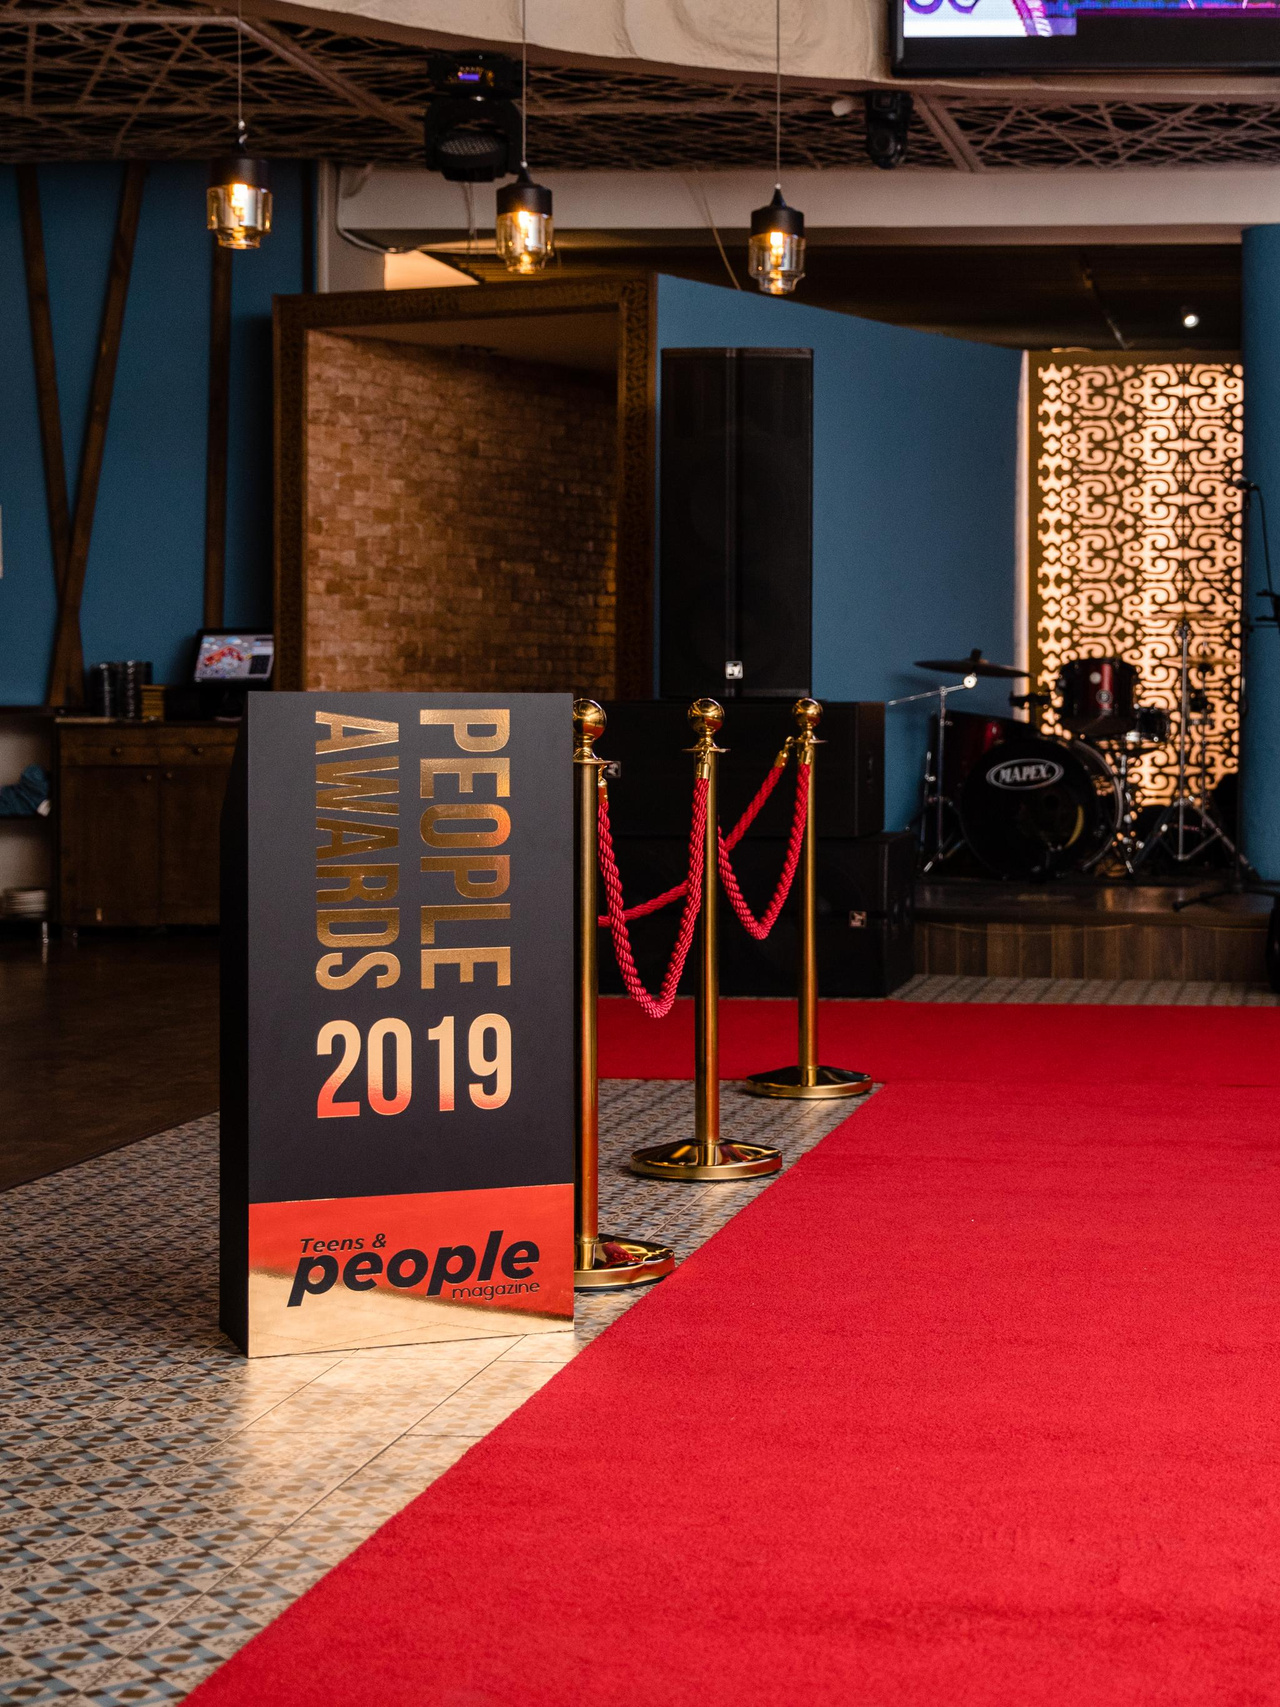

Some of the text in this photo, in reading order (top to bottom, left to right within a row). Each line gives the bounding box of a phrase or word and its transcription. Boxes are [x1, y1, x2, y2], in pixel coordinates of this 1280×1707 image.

[999, 763, 1051, 784] MAPEX
[315, 710, 401, 990] AWARDS
[419, 708, 511, 989] PEOPLE
[316, 1013, 512, 1119] 2019
[287, 1230, 540, 1307] people
[301, 1233, 387, 1254] Teens &
[452, 1280, 541, 1300] magazine
